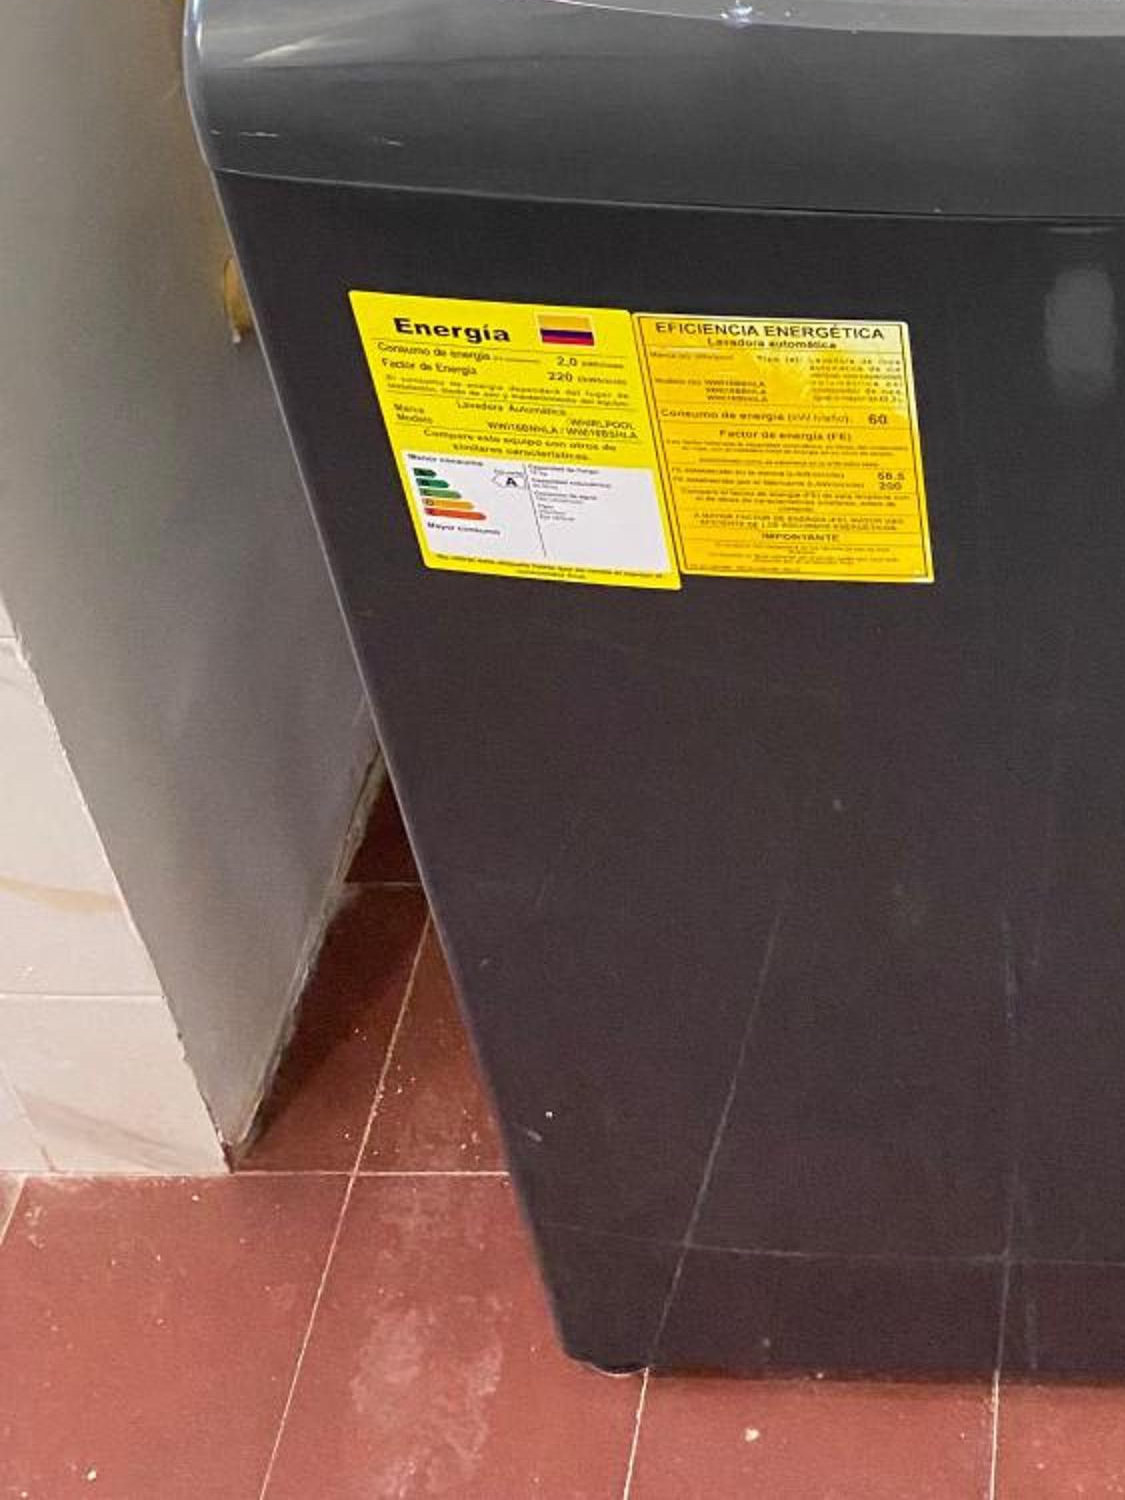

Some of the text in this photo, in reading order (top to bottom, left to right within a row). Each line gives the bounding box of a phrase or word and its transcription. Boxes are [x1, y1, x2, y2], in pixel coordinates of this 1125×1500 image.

[393, 317, 511, 344] Energía
[655, 321, 885, 340] EFICIENCIA ENERGÉTICA
[377, 341, 431, 357] Consumo
[433, 348, 447, 357] de
[706, 337, 765, 348] Lavadora
[419, 361, 433, 371] de
[660, 408, 717, 420] Consumo
[721, 412, 736, 421] de
[739, 413, 784, 424] energía
[868, 414, 889, 426] 60
[760, 431, 775, 441] de
[505, 475, 518, 488] A
